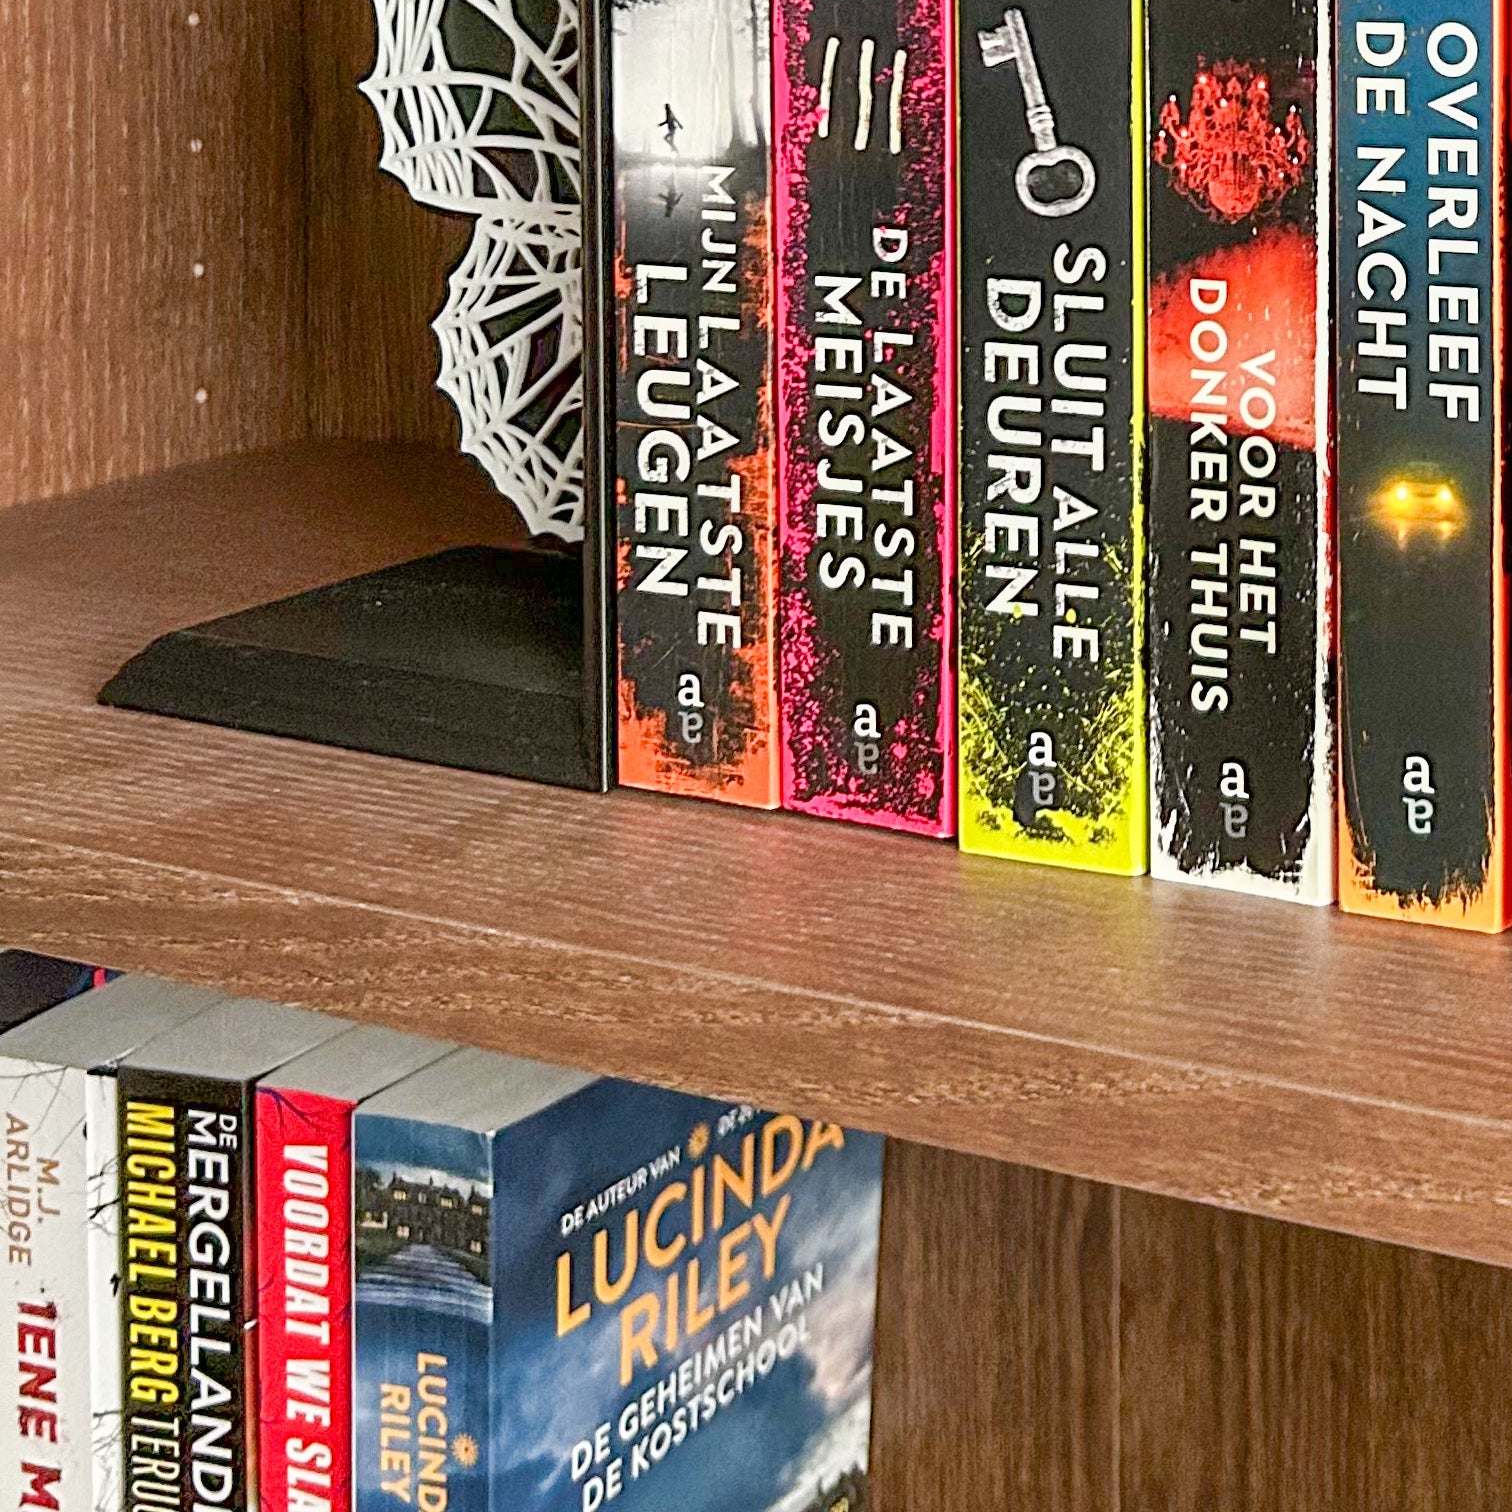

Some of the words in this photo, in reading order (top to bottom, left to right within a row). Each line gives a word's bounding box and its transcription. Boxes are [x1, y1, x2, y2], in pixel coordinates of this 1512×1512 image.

[1355, 21, 1406, 115] DE
[701, 165, 737, 293] MIJN
[871, 228, 909, 300] DE
[1356, 146, 1408, 410] NACHT
[1426, 21, 1480, 423] OVERLEEF
[634, 263, 691, 597] LEUGEN
[814, 274, 866, 590] MEISJES
[984, 277, 1042, 618] DEUREN
[1052, 241, 1108, 472] SLUIT
[1188, 278, 1228, 522] DONKER
[1238, 349, 1277, 519] VOOR
[697, 316, 743, 649] LAATSTE
[871, 331, 915, 649] LAATSTE
[1052, 485, 1100, 663] ALLE
[1190, 543, 1229, 712] THUIS
[1238, 539, 1277, 655] HET
[5, 1111, 32, 1267] ARLIDGE
[36, 1156, 61, 1224] M.J.
[125, 1101, 177, 1283] MICHAEL
[217, 1114, 238, 1149] DE
[586, 1167, 648, 1222] AUTEUR
[648, 1144, 681, 1180] VAN
[186, 1108, 234, 1512] MERGELLAND
[283, 1143, 332, 1345] VOORDAT
[555, 1113, 846, 1338] LUCINDA
[619, 1192, 792, 1388] RILEY
[127, 1294, 180, 1407] BERG
[285, 1358, 331, 1429] WE
[571, 1421, 612, 1482] DE
[617, 1305, 763, 1441] GEHEIMEN
[769, 1261, 824, 1322] VAN
[582, 1457, 623, 1512] DE
[630, 1314, 812, 1480] KOSTSCHOOL
[285, 1436, 332, 1512] SLA
[379, 1382, 412, 1504] RILEY
